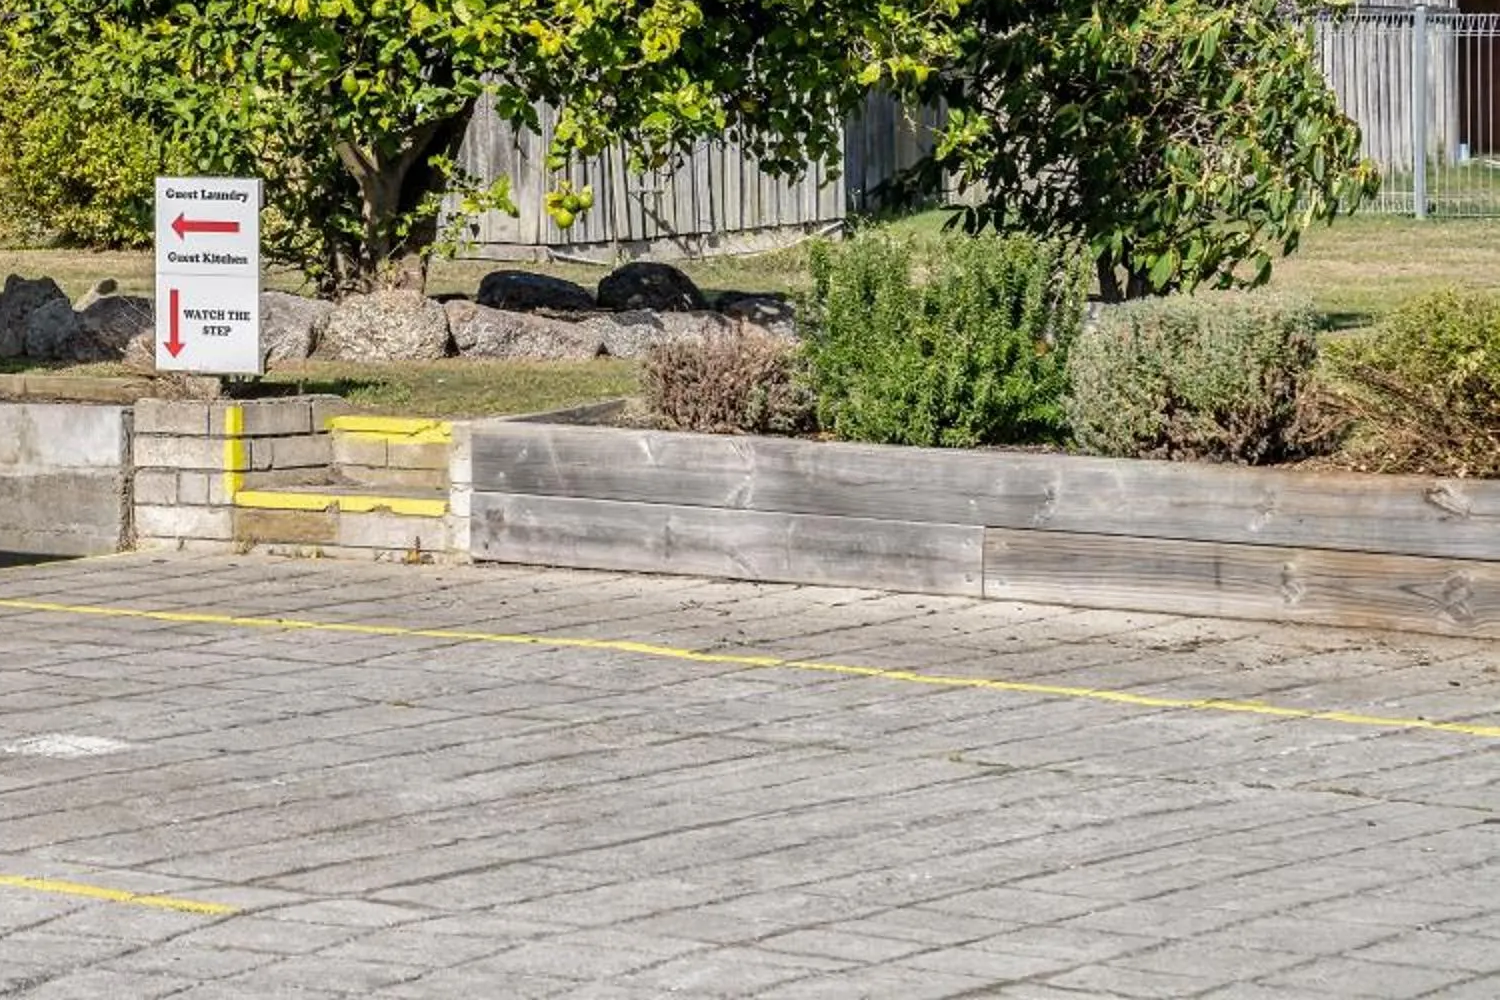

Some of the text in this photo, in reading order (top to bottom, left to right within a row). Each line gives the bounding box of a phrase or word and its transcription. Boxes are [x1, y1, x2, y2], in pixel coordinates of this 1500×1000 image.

[165, 187, 249, 203] Guest Laundry
[167, 251, 248, 265] Guest Kitchen
[183, 309, 251, 321] WATCH THE
[202, 325, 232, 337] STEP
